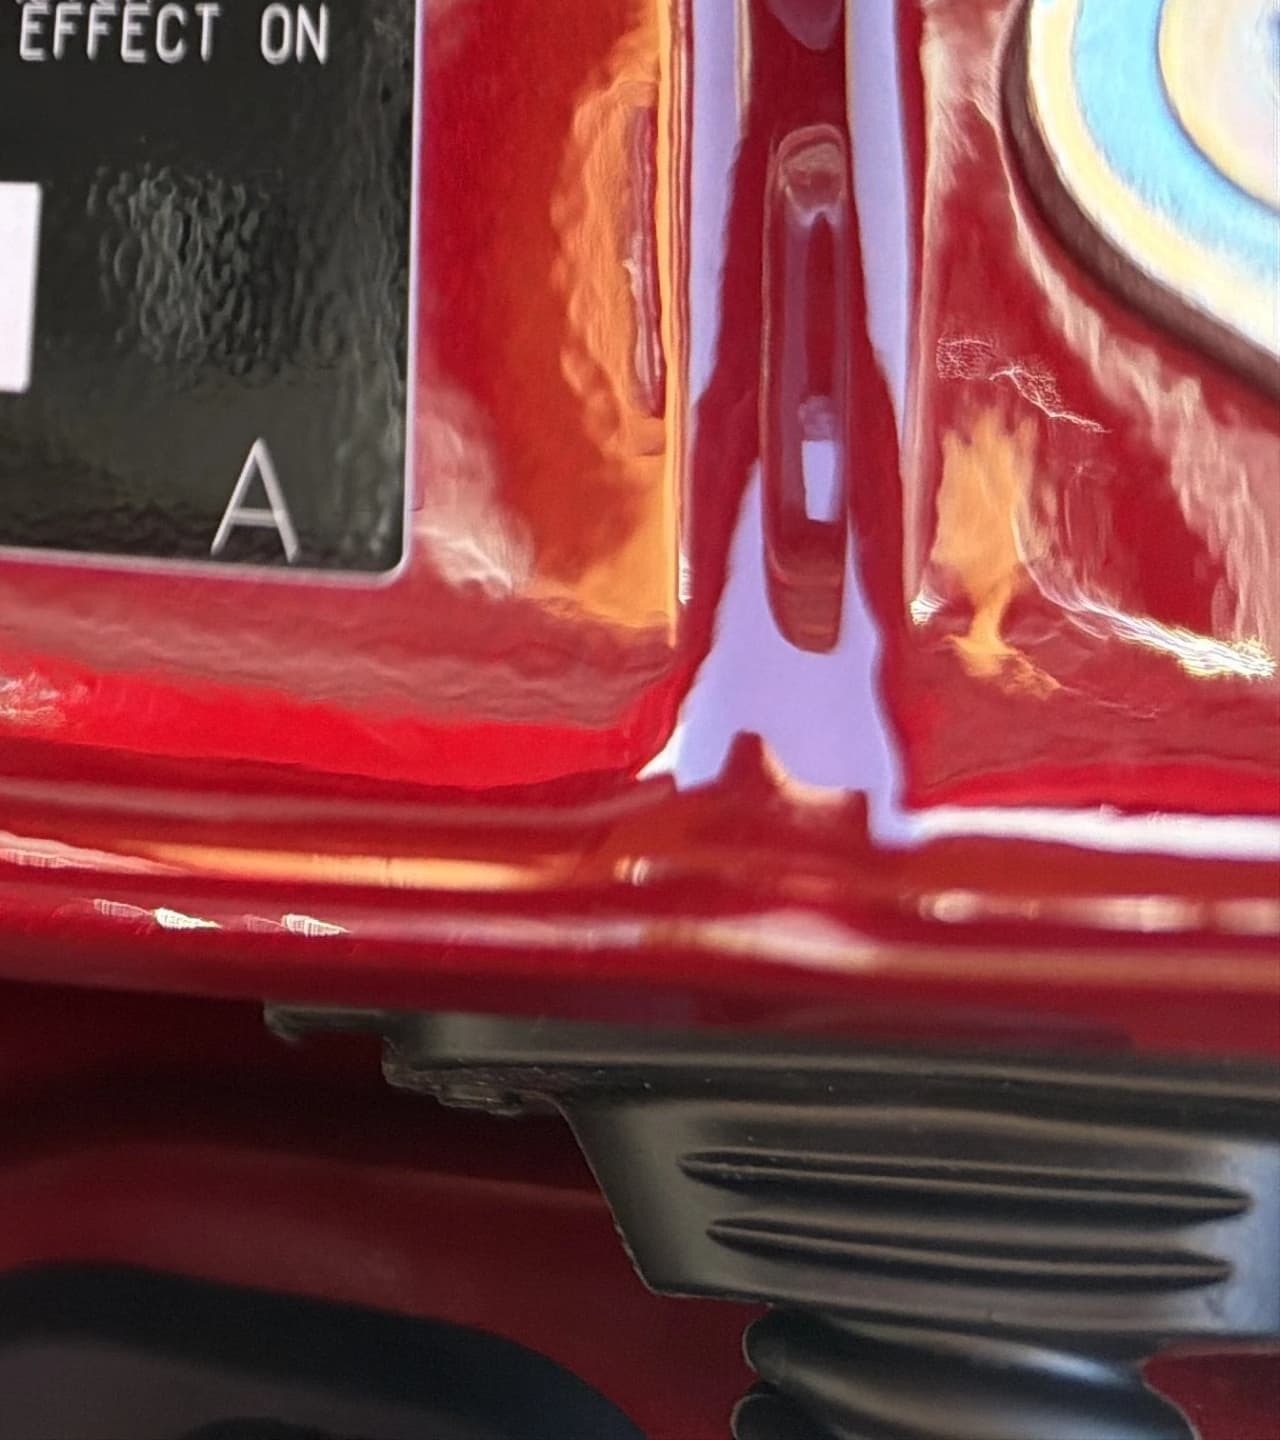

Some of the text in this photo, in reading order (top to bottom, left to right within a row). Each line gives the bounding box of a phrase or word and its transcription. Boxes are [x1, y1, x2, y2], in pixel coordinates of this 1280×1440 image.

[19, 1, 222, 62] EFFECT
[259, 3, 330, 64] ON
[210, 437, 300, 563] A
